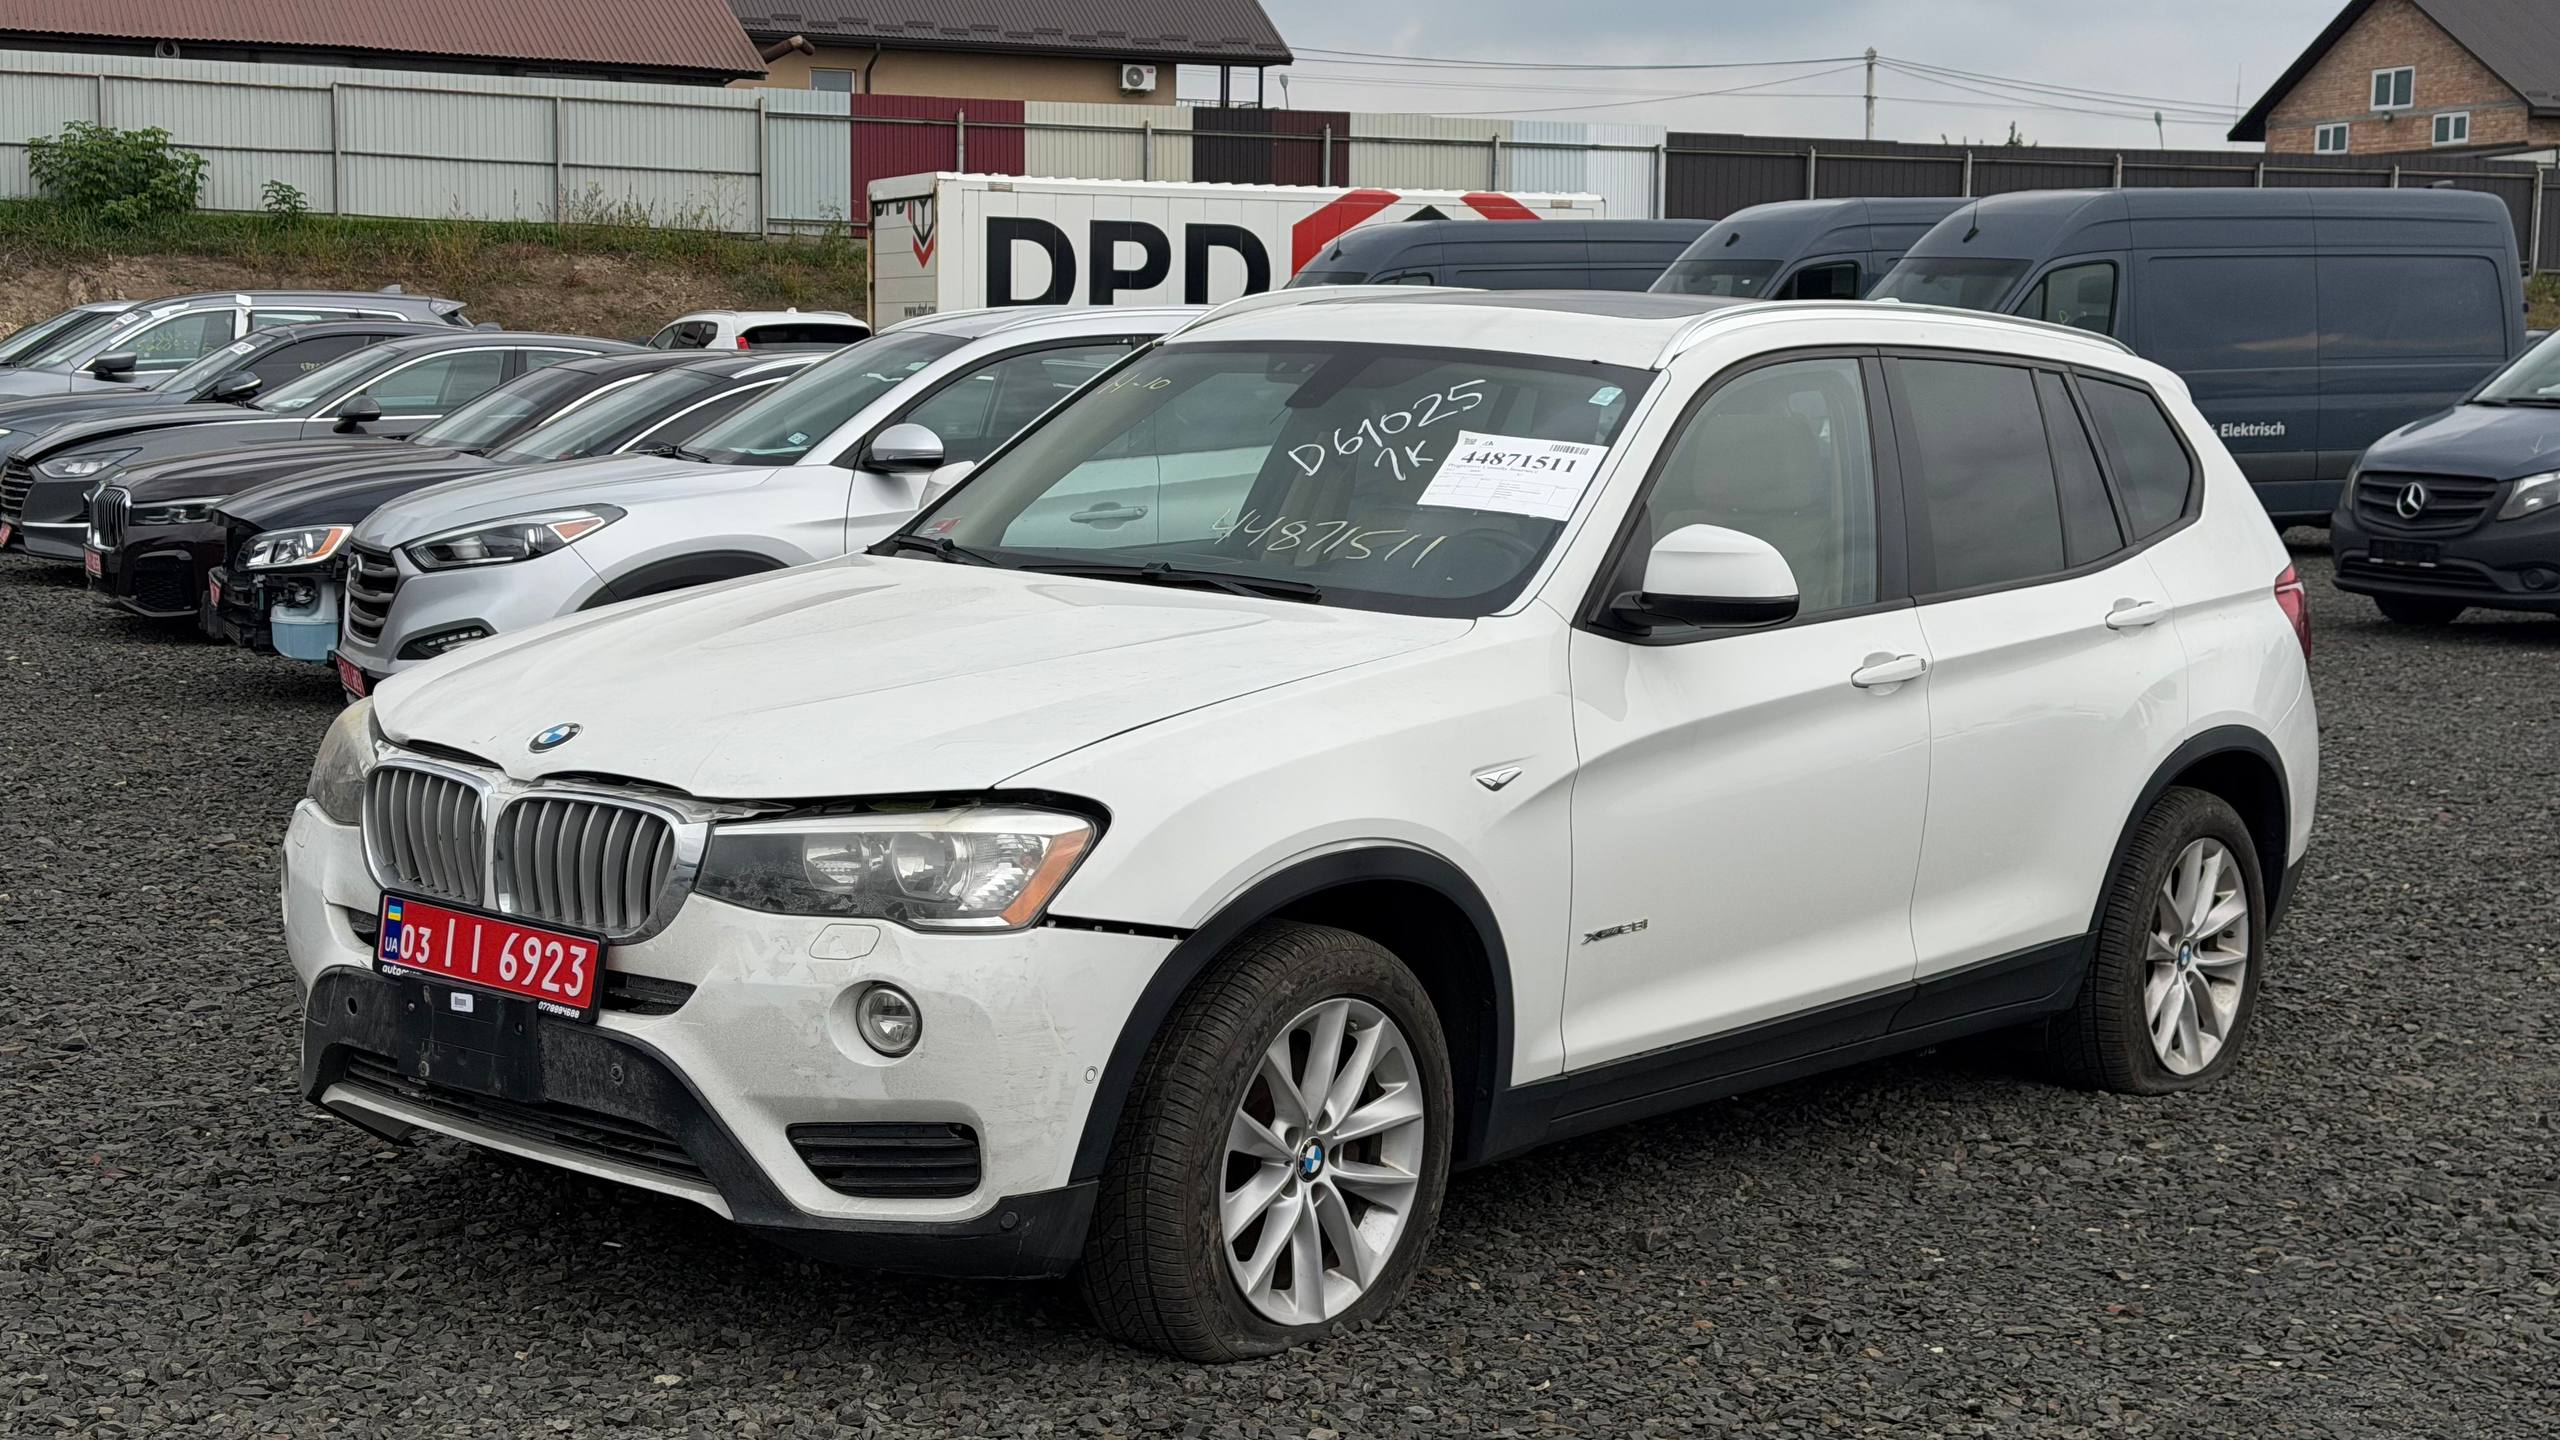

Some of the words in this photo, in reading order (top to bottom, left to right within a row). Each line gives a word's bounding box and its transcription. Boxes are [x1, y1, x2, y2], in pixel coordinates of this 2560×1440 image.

[986, 216, 1271, 308] DPD
[2221, 421, 2285, 437] Elektrisch
[1461, 450, 1577, 473] 44871511
[1212, 508, 1448, 569] 44871511
[384, 937, 398, 953] UA
[499, 932, 588, 997] 6923
